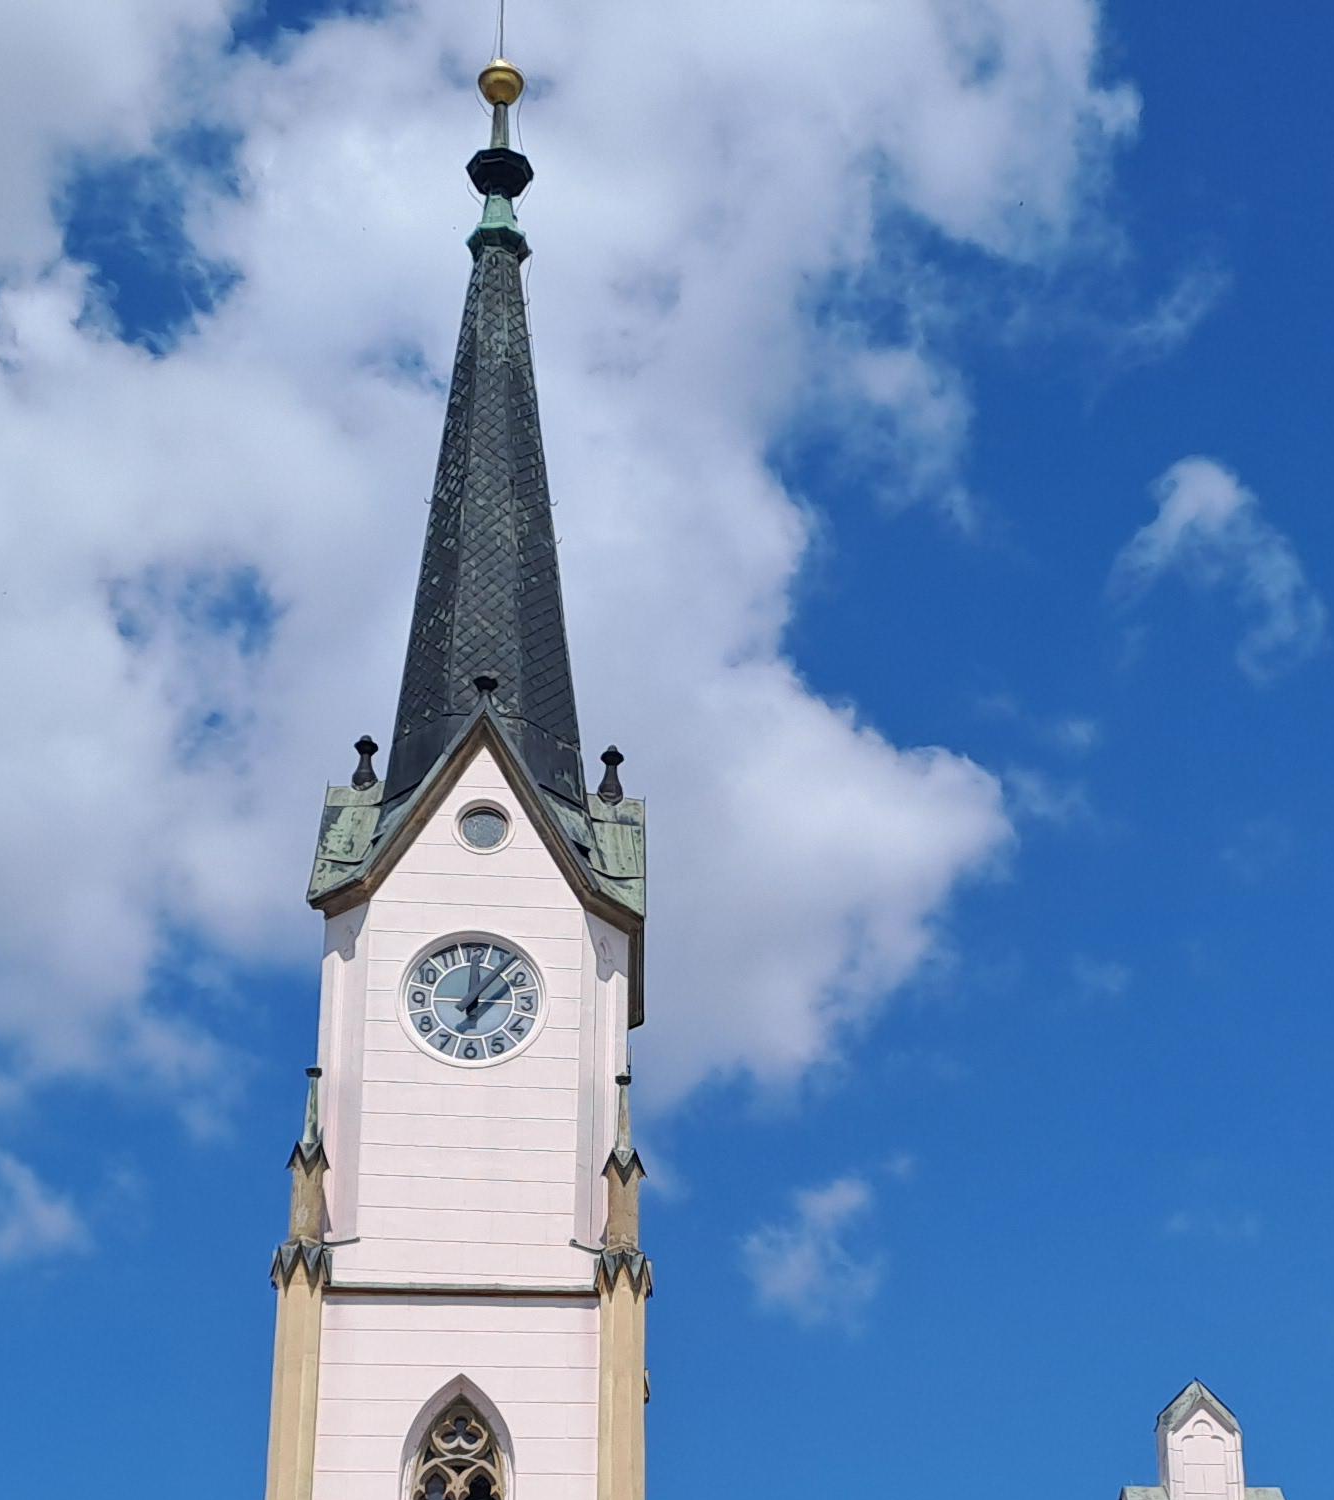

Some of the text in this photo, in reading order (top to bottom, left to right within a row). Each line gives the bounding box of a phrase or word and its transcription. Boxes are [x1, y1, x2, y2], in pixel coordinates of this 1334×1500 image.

[419, 967, 436, 984] 10
[513, 972, 526, 987] 2
[412, 991, 425, 1007] 9
[521, 996, 533, 1011] 3
[419, 1016, 432, 1032] 8
[509, 1018, 524, 1035] 4
[439, 1034, 451, 1049] 7
[491, 1037, 504, 1053] 5
[464, 1042, 477, 1058] 6
